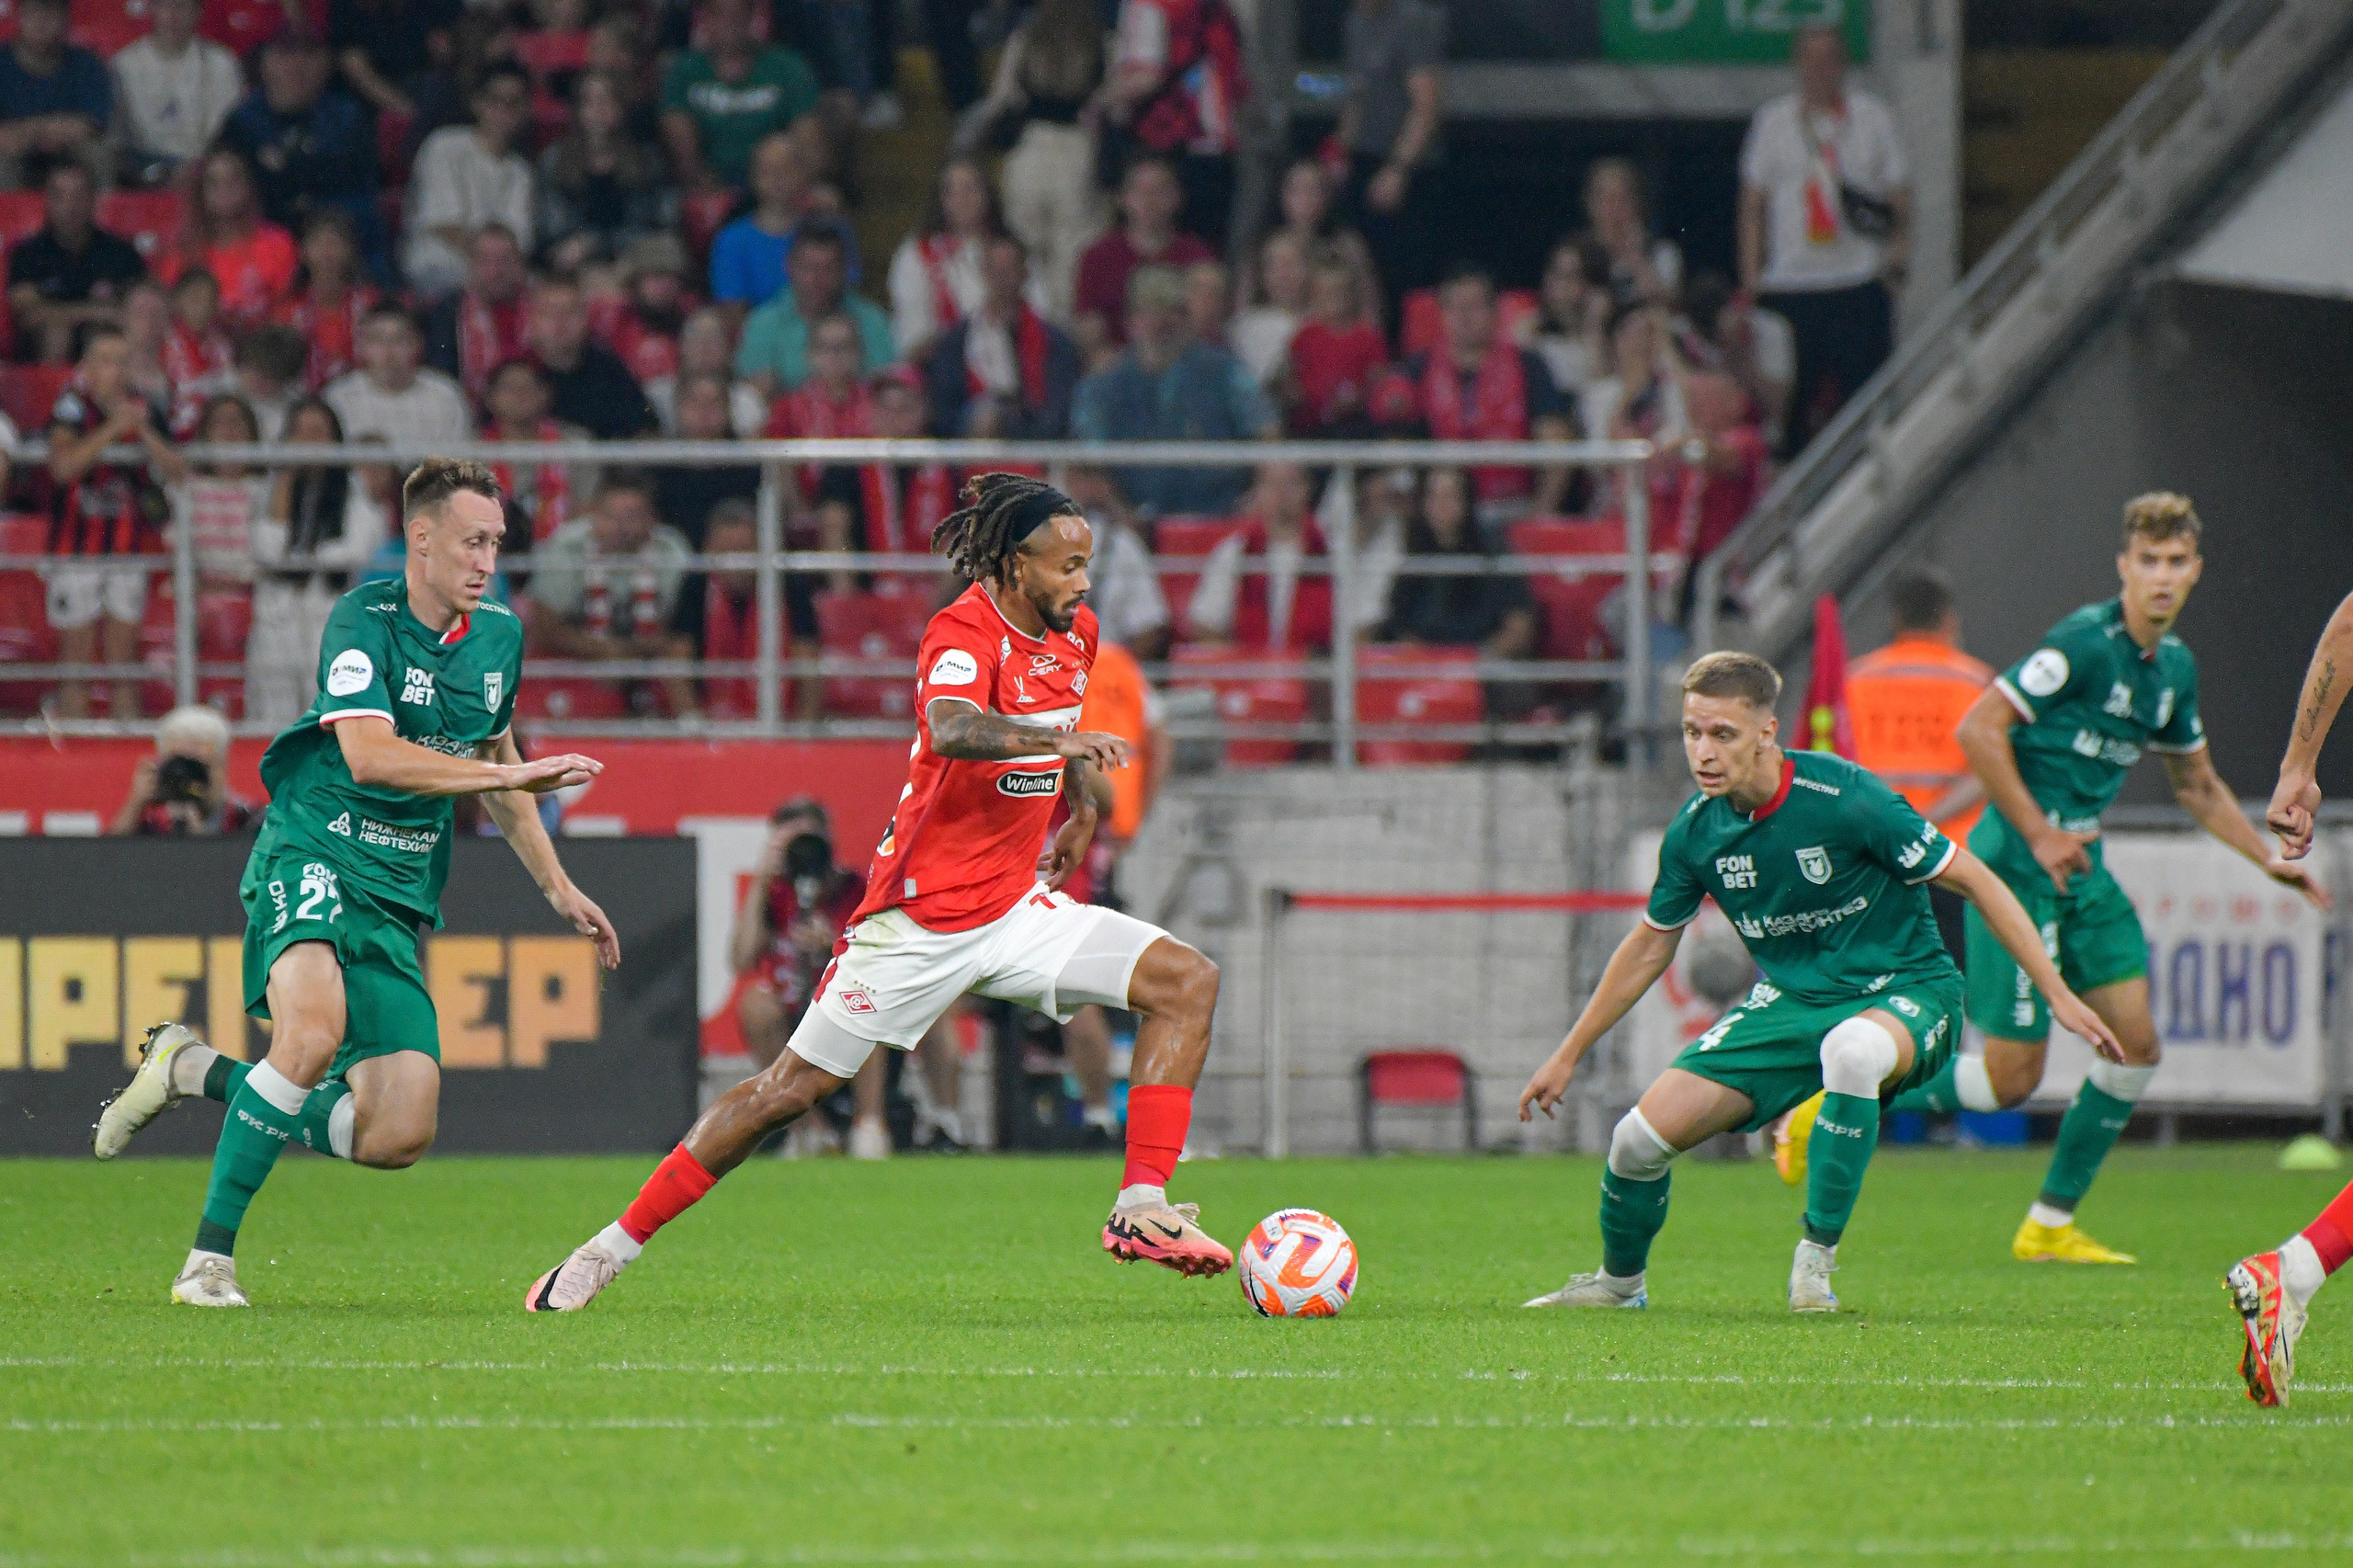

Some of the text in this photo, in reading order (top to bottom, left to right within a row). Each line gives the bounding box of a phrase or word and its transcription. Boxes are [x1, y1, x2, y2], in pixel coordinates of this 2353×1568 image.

[404, 666, 435, 687] FON
[400, 684, 436, 707] BET
[1006, 775, 1054, 792] Winline
[361, 817, 441, 844] НИЖНЕКАМ
[1715, 854, 1753, 874] FON
[1722, 869, 1757, 889] BET
[0, 936, 601, 1070] РЕЕР
[2148, 937, 2298, 1048] ДНО
